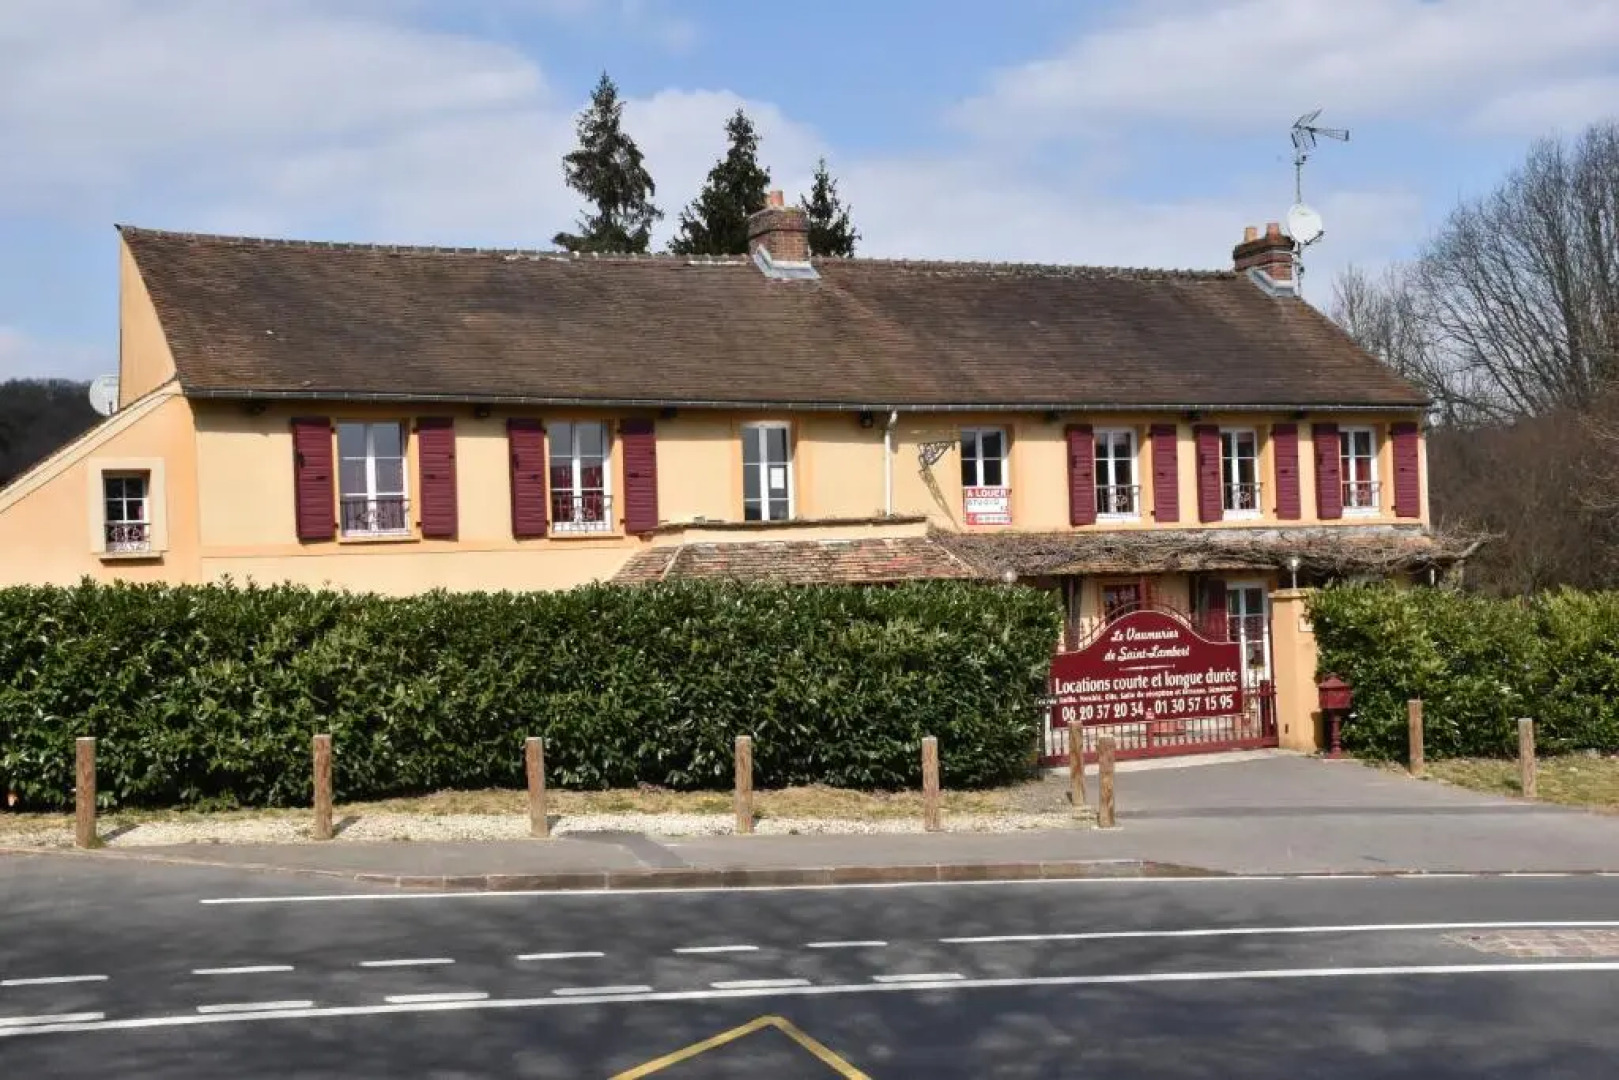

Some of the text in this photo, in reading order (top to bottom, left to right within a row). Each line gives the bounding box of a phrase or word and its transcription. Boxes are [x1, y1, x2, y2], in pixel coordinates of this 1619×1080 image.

[976, 489, 1006, 498] LOUER
[1111, 630, 1123, 641] Le
[1104, 644, 1190, 661] de Saint-Lambert
[1055, 666, 1238, 694] Locations courte et longue durée
[1062, 704, 1076, 721] 06
[1079, 704, 1094, 720] 20
[1096, 703, 1111, 719] 37
[1113, 702, 1128, 718] 20
[1130, 700, 1144, 717] 34
[1155, 699, 1168, 714] 01
[1171, 697, 1185, 714] 30
[1188, 696, 1201, 712] 57
[1204, 695, 1217, 711] 15
[1219, 694, 1234, 709] 95
